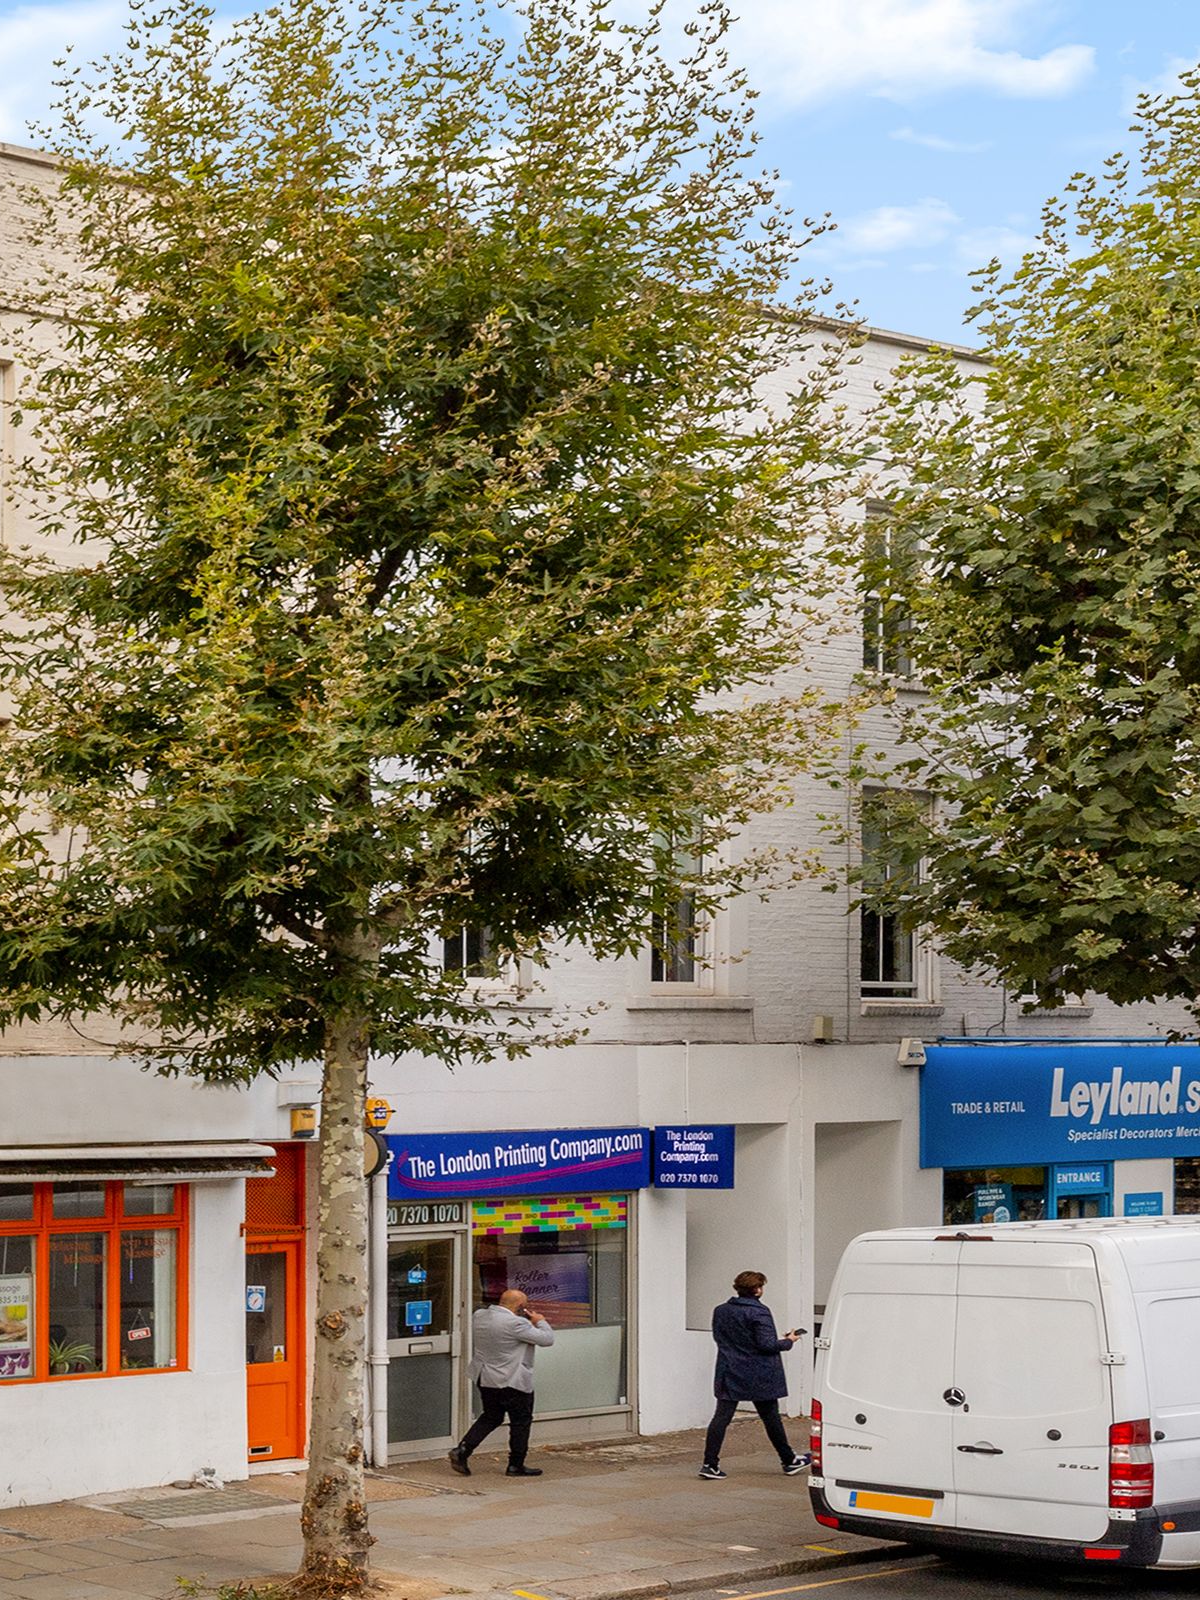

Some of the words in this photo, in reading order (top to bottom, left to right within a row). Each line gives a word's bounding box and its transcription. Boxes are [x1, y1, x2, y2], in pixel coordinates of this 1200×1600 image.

[1050, 1066, 1182, 1125] Leyland
[951, 1103, 983, 1114] TRADE
[985, 1102, 991, 1113] &
[993, 1101, 1026, 1113] RETAIL
[666, 1130, 681, 1140] The
[683, 1130, 714, 1140] London
[1067, 1128, 1118, 1143] Specialist
[673, 1141, 706, 1153] Printing
[409, 1156, 436, 1179] The
[440, 1150, 491, 1176] London
[495, 1144, 548, 1168] Printing
[550, 1132, 644, 1161] Company.com
[660, 1150, 719, 1163] Company.com
[660, 1173, 675, 1183] 020
[677, 1173, 698, 1183] 7370
[699, 1173, 719, 1183] 1070
[1056, 1171, 1101, 1184] ENTRANCE
[400, 1205, 429, 1224] 7370
[432, 1204, 460, 1223] 1070
[514, 1269, 549, 1283] Roller
